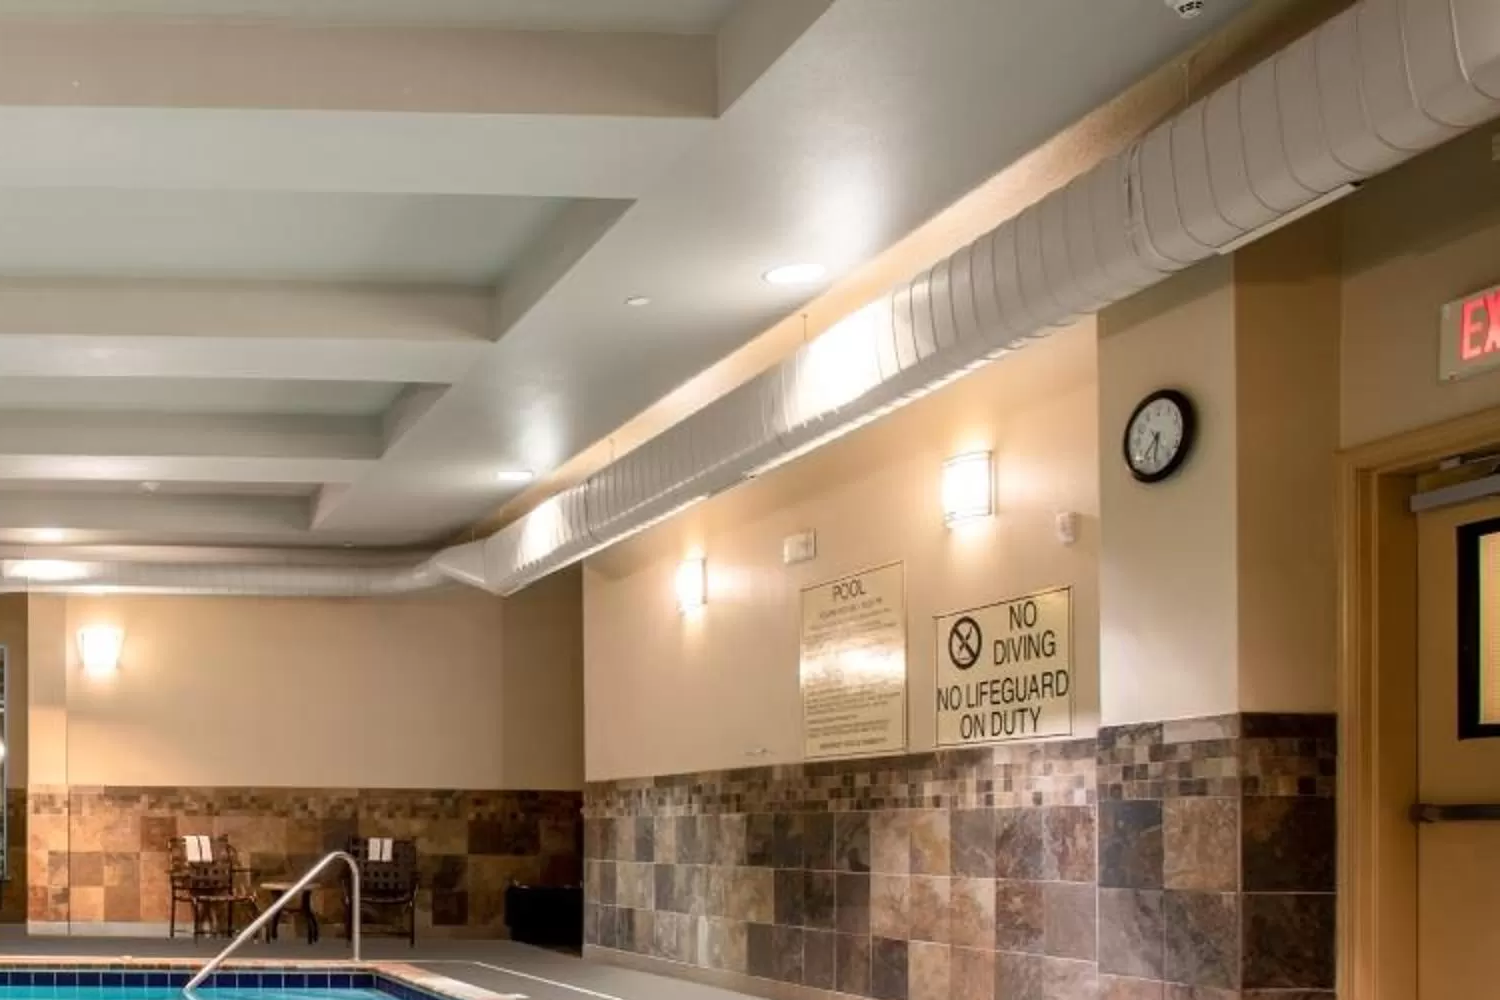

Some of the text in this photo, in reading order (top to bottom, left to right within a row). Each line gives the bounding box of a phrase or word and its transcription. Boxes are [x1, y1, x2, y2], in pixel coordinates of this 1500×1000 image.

[832, 579, 867, 602] POOL
[1009, 601, 1037, 631] NO
[993, 629, 1056, 665] DIVING
[937, 685, 962, 712] NO
[965, 669, 1069, 708] LIFEGUARD
[960, 706, 1041, 739] ON DUTY
